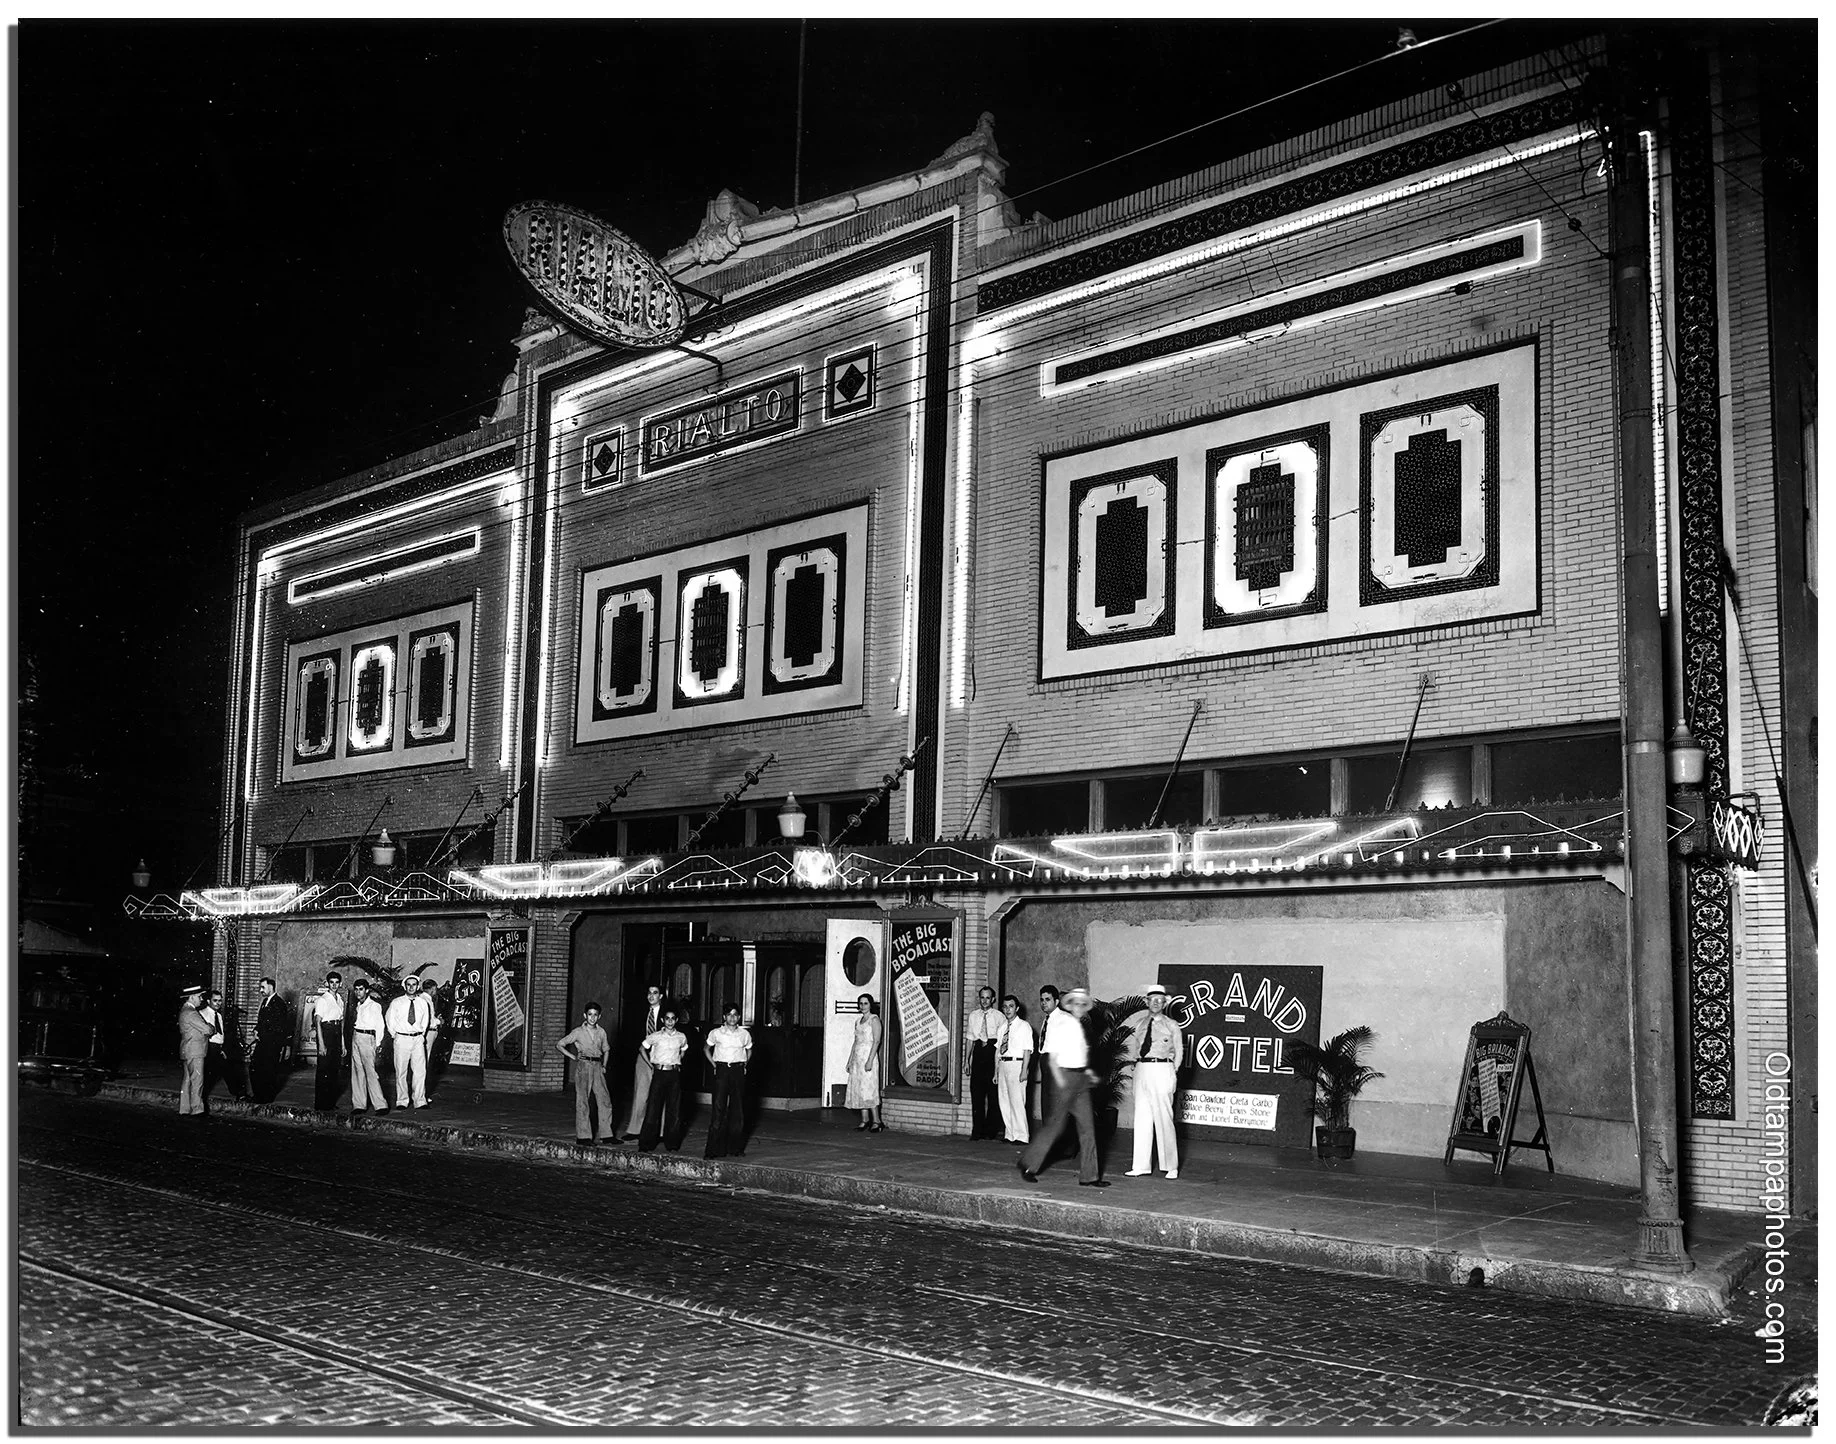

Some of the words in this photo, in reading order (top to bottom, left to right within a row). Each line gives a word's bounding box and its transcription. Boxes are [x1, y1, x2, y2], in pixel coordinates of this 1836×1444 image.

[651, 389, 787, 459] RIALTO
[491, 936, 505, 954] THE
[506, 930, 520, 944] BIG
[891, 937, 952, 973] BROADCAST
[892, 930, 914, 952] THE
[915, 923, 937, 940] BIG
[1166, 972, 1307, 1034] GRAND
